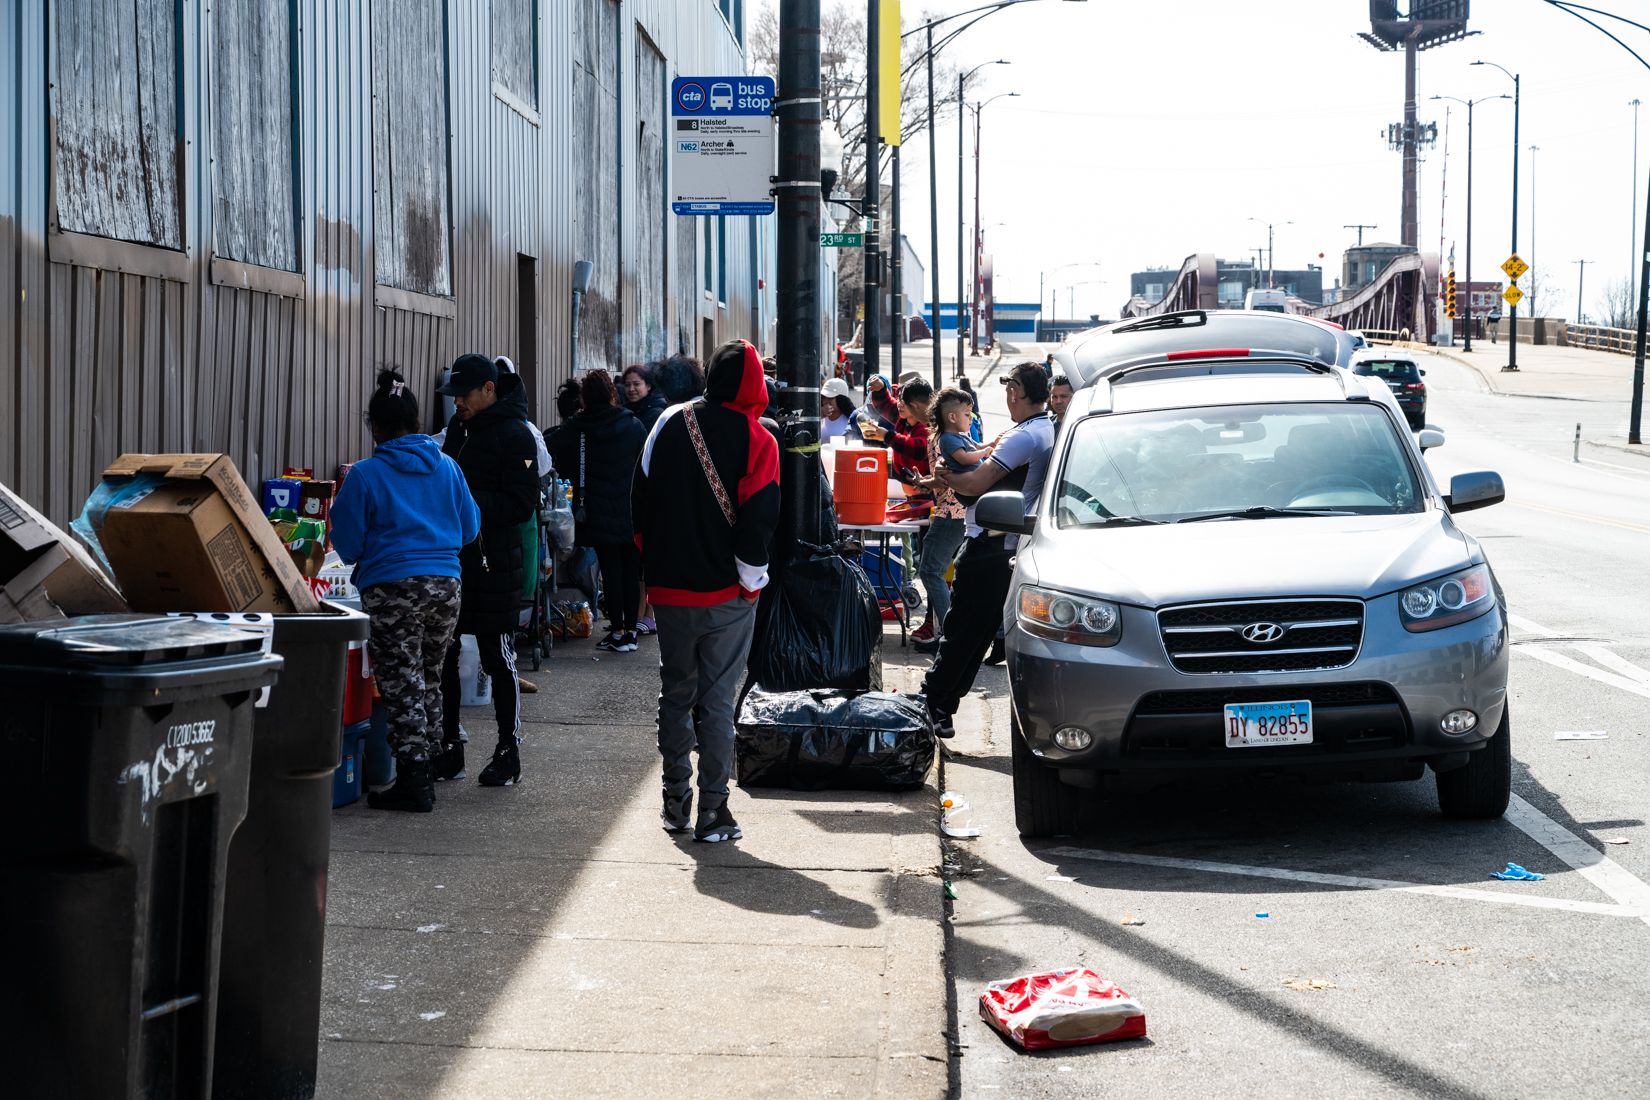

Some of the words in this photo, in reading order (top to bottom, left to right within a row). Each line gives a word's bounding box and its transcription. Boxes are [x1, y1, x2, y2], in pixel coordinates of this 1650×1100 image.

[738, 82, 765, 95] bus
[682, 92, 701, 101] cta
[738, 96, 770, 112] stop
[691, 121, 697, 129] 8
[680, 143, 697, 151] N62
[1229, 716, 1248, 738] DY
[1258, 714, 1308, 736] 82855
